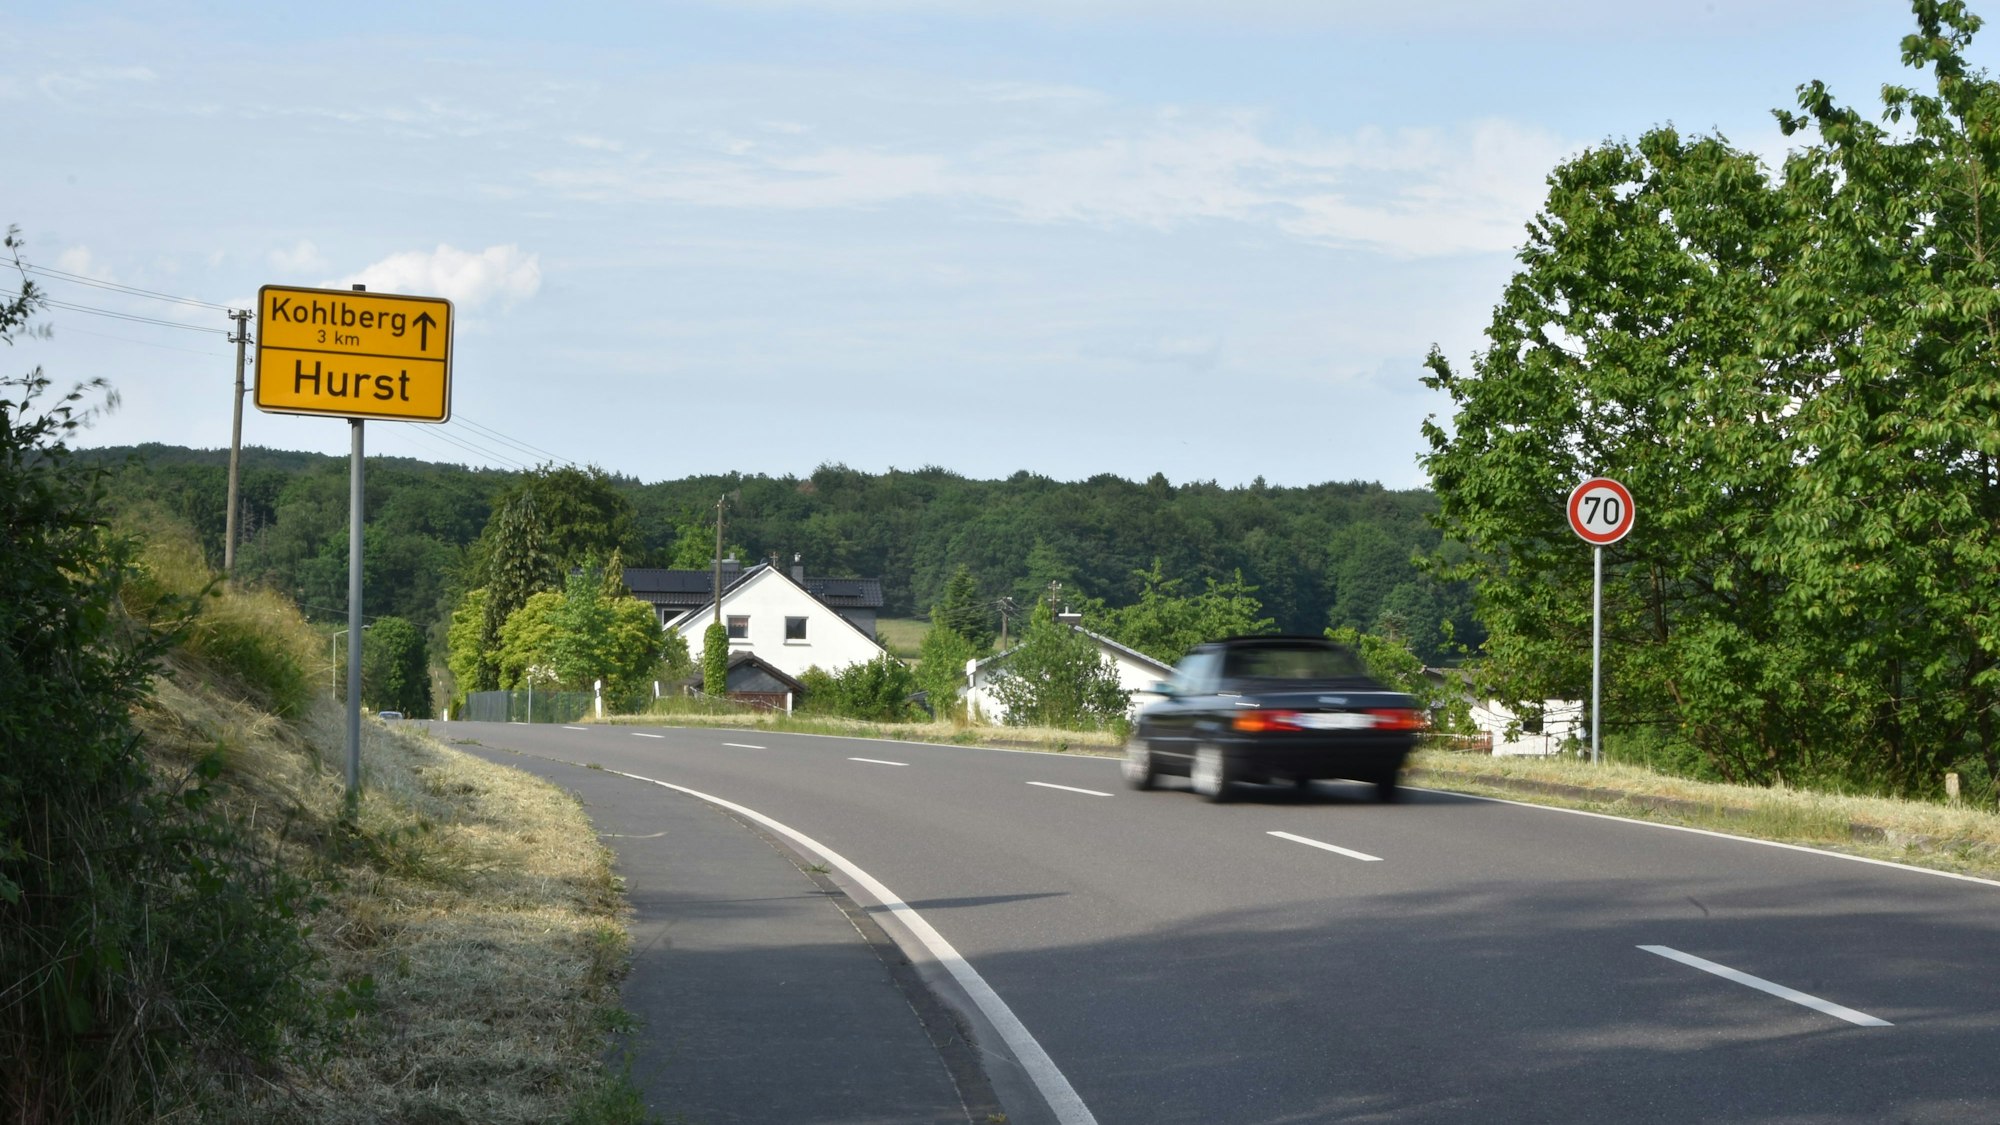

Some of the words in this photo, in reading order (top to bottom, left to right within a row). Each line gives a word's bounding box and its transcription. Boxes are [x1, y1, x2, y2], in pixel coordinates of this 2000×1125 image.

[272, 297, 406, 337] Kohlberg
[317, 330, 326, 344] 3
[335, 331, 360, 346] km
[294, 359, 410, 402] Hurst
[1584, 496, 1620, 526] 70
